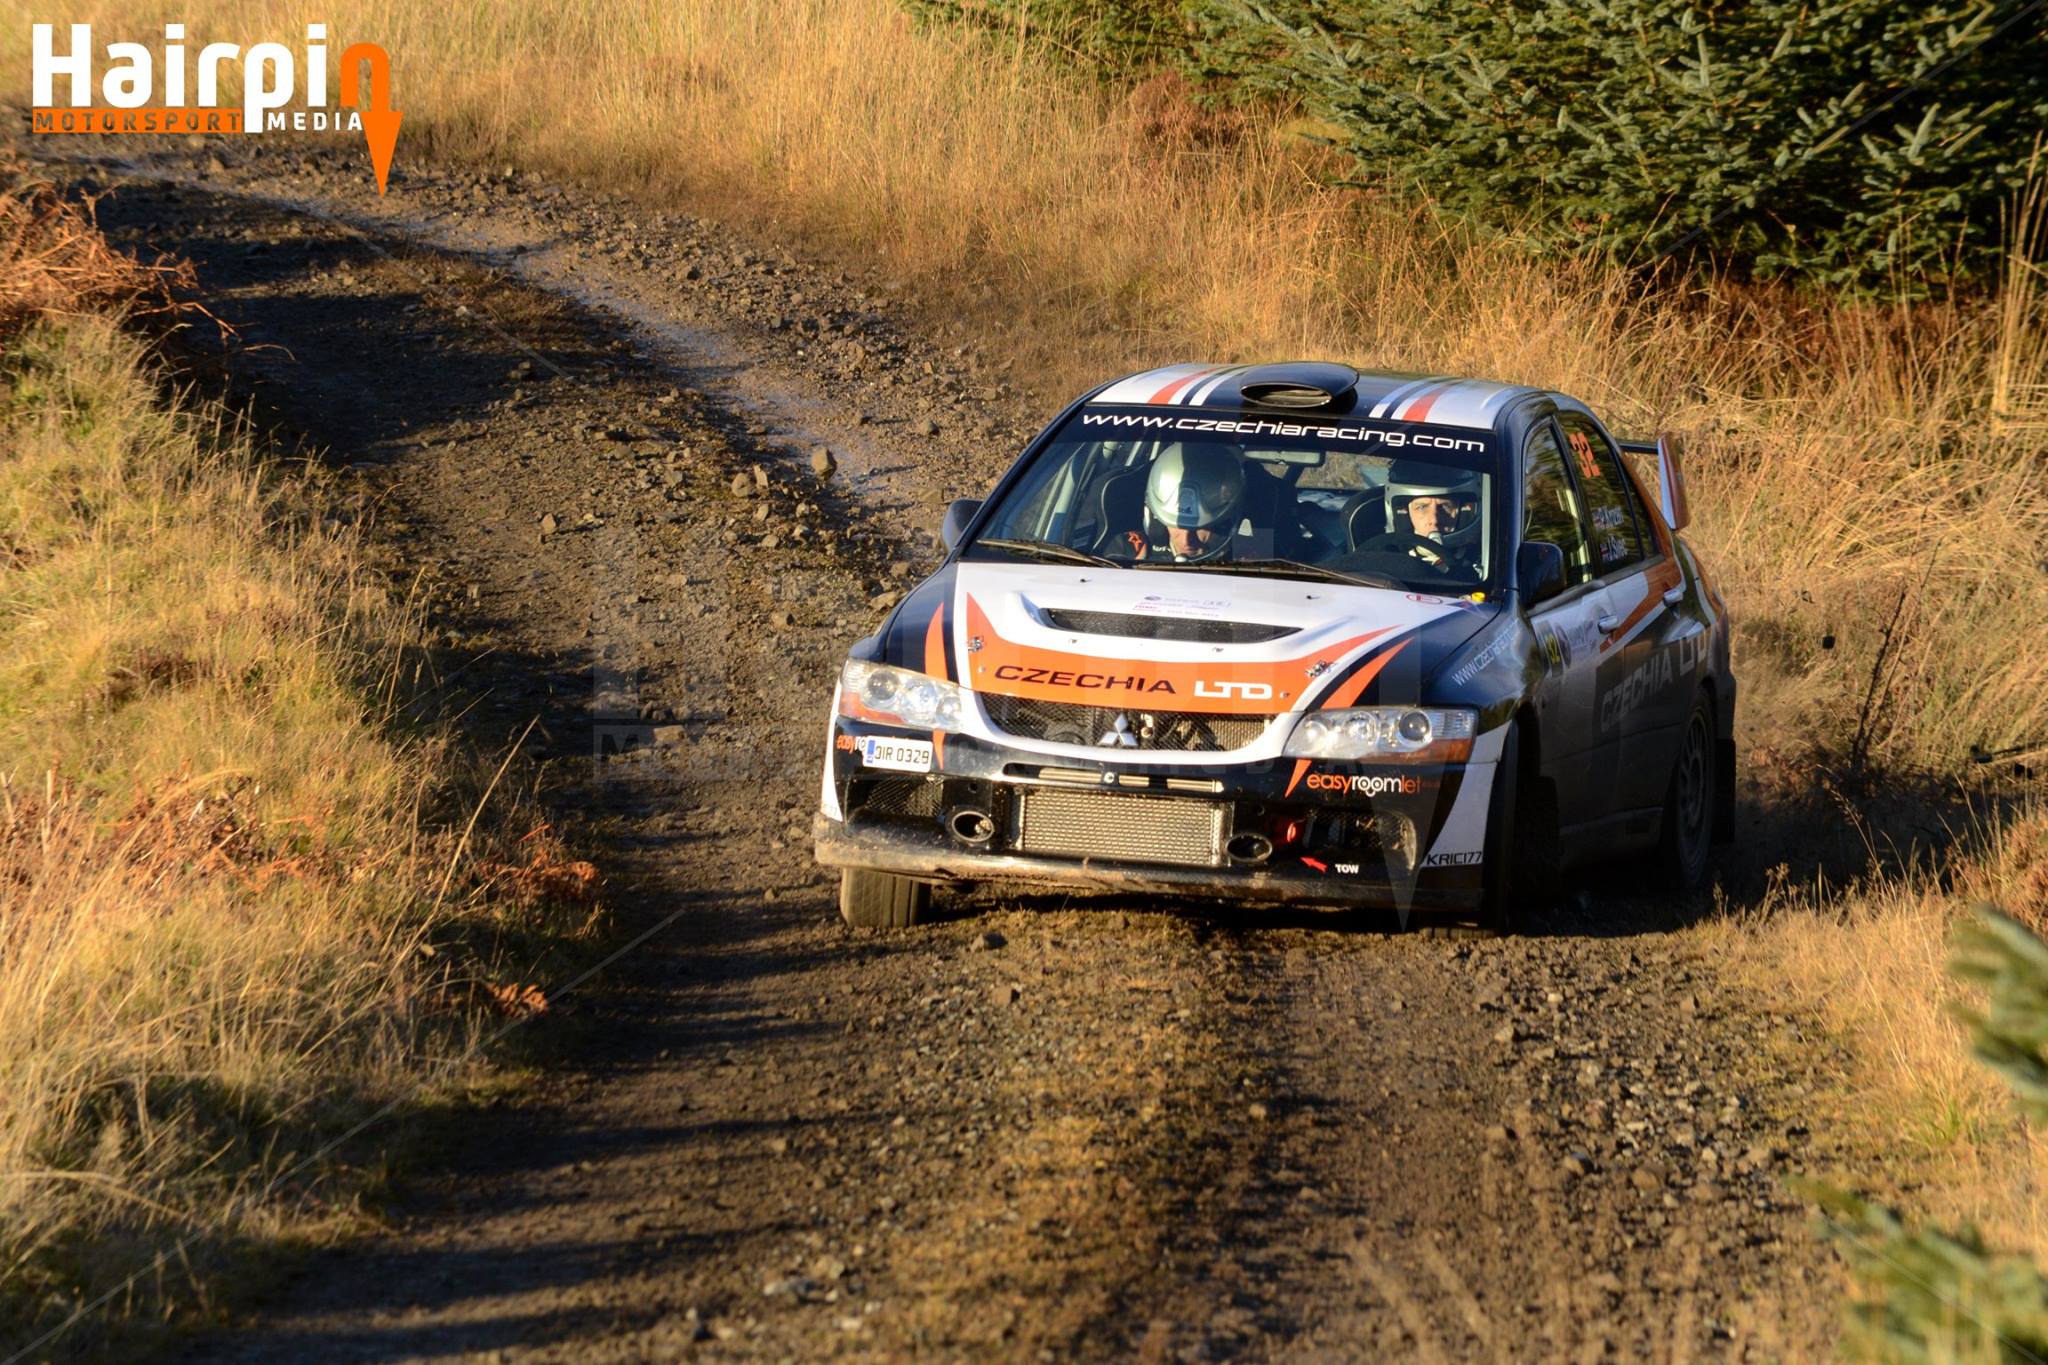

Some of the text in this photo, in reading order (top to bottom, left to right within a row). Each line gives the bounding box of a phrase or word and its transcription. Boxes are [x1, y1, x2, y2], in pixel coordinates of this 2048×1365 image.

[1083, 412, 1486, 453] www.czechiaracing.com
[994, 665, 1274, 700] CZECHIA LTD
[1600, 648, 1673, 734] CZECHIA
[1306, 773, 1421, 797] easyroomlet
[1335, 864, 1360, 874] TOW
